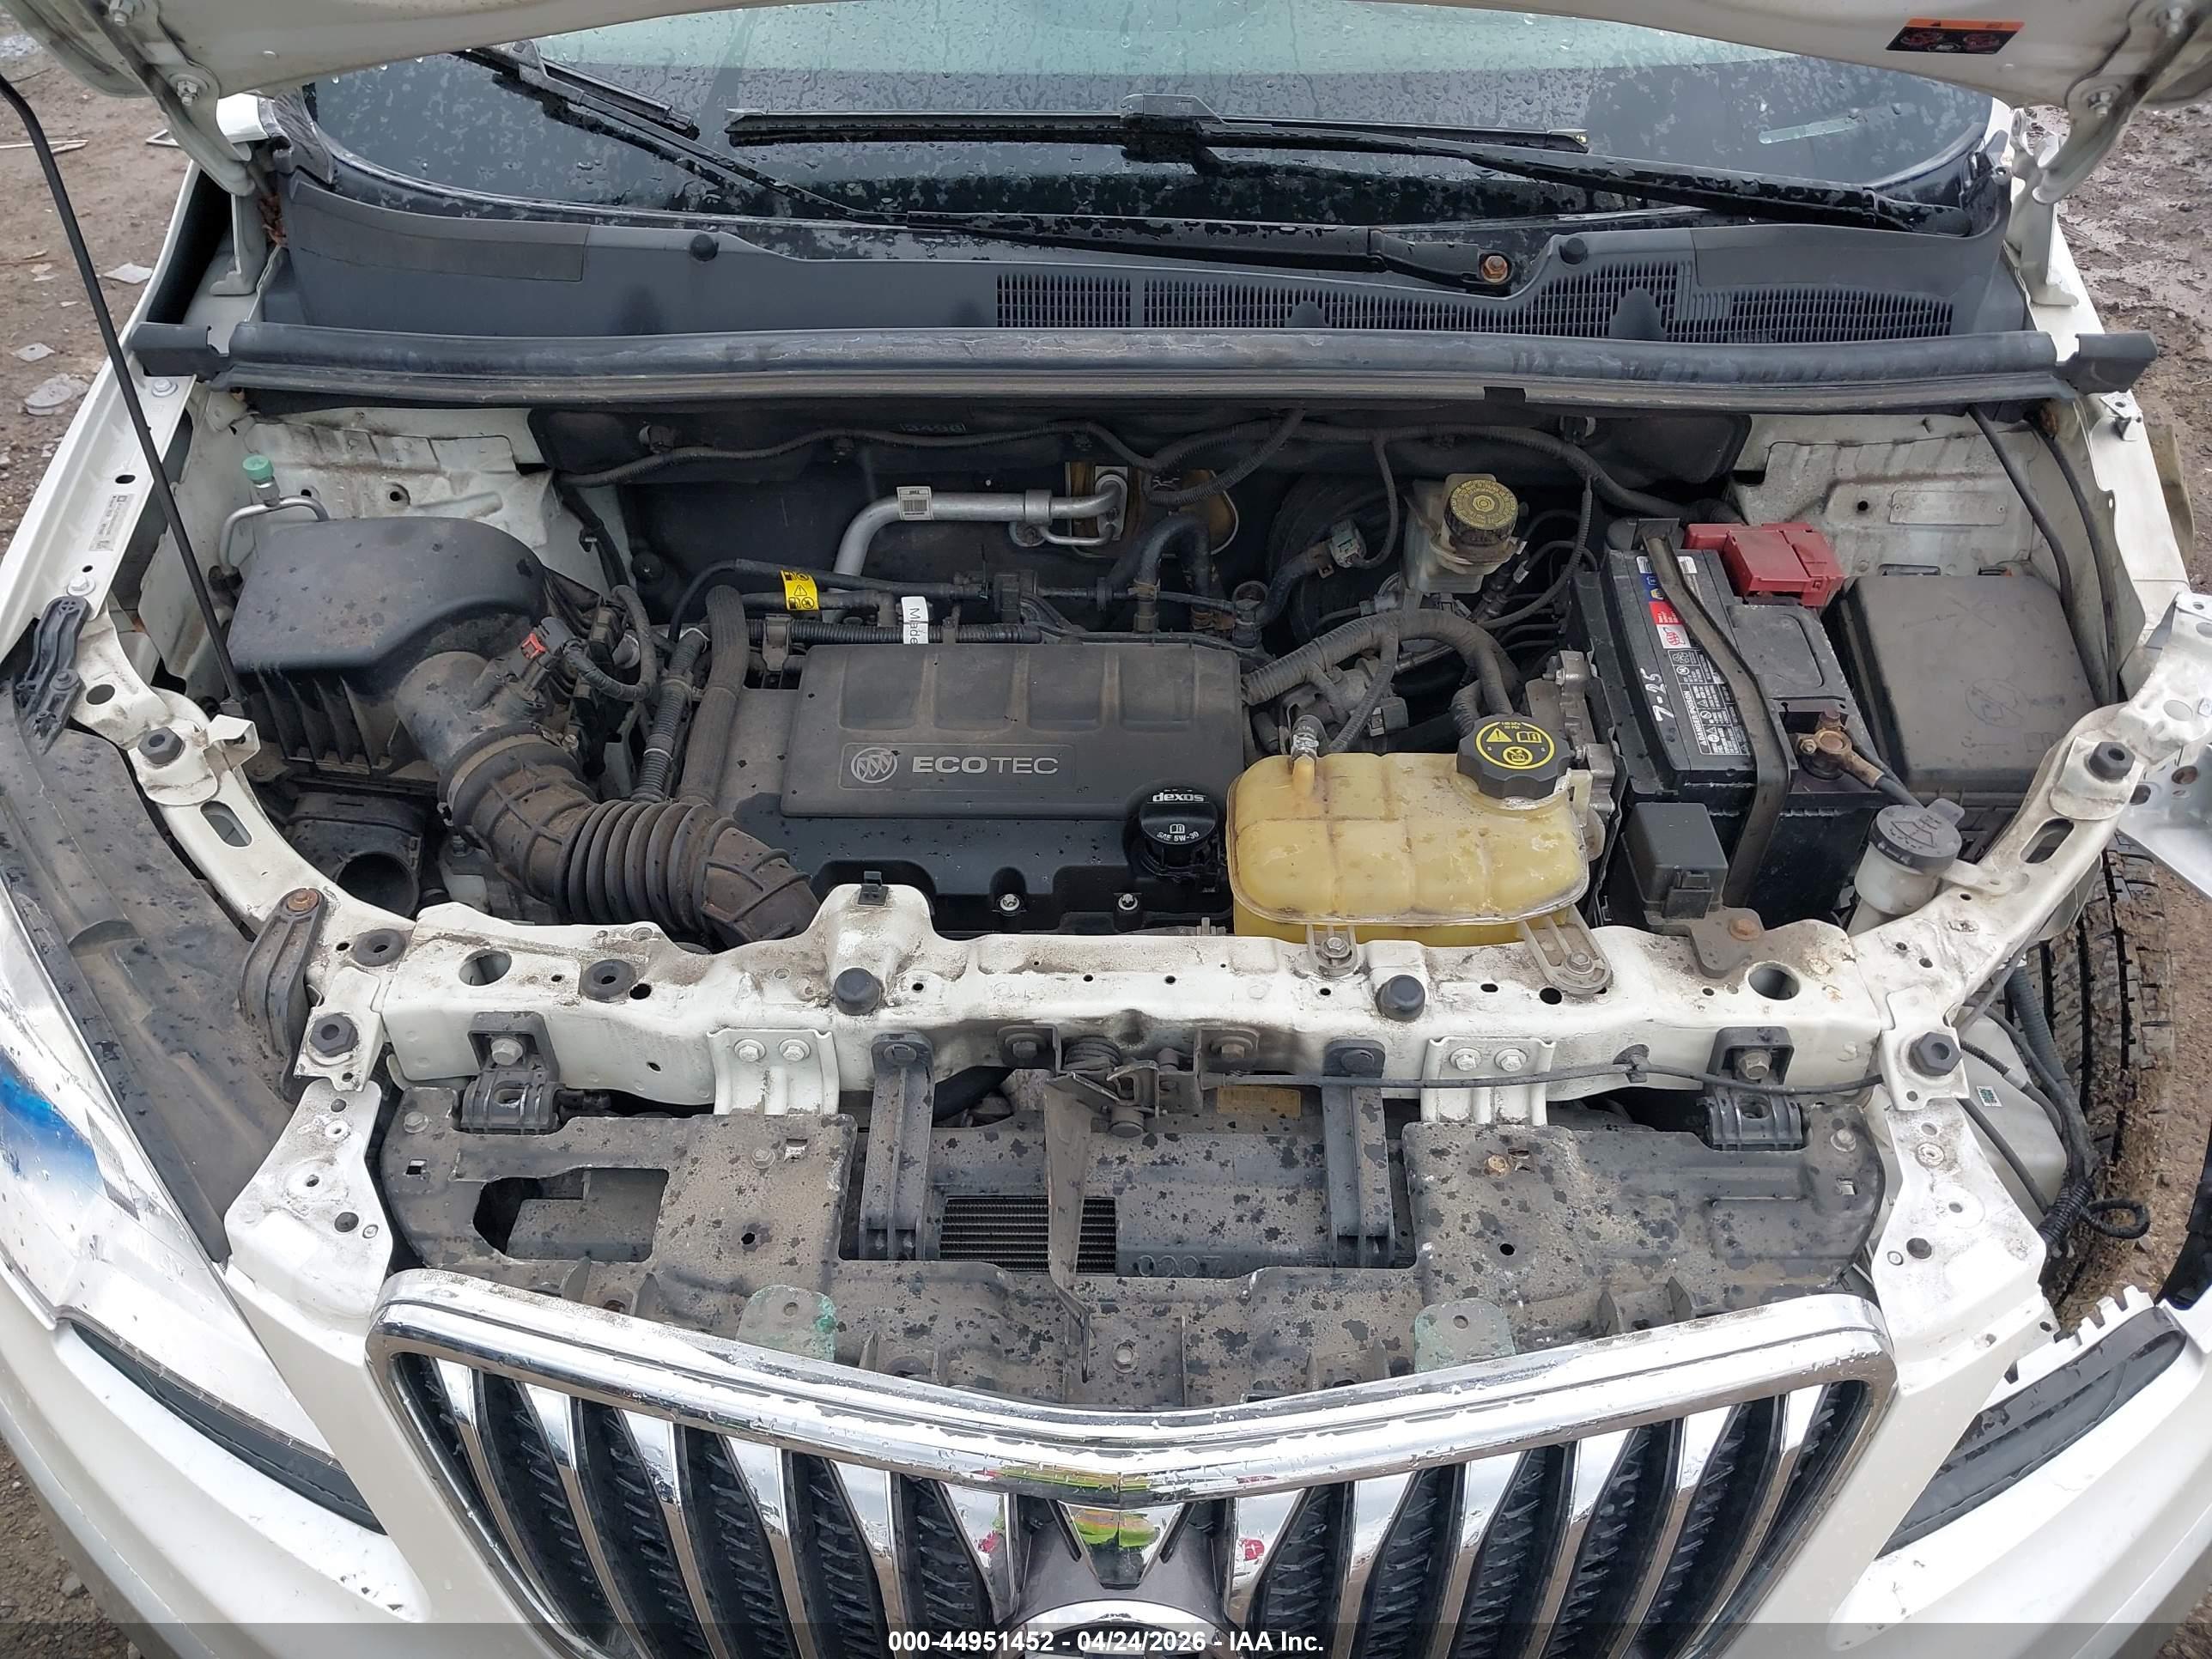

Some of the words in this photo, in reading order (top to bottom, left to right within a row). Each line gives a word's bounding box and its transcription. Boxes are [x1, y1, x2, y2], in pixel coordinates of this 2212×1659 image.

[908, 608, 921, 645] Made
[1639, 668, 1674, 722] 7-25
[912, 756, 1059, 775] ECOTEC
[1152, 792, 1205, 802] dexos
[1157, 831, 1171, 842] SAE
[1174, 831, 1200, 842] 5W-30
